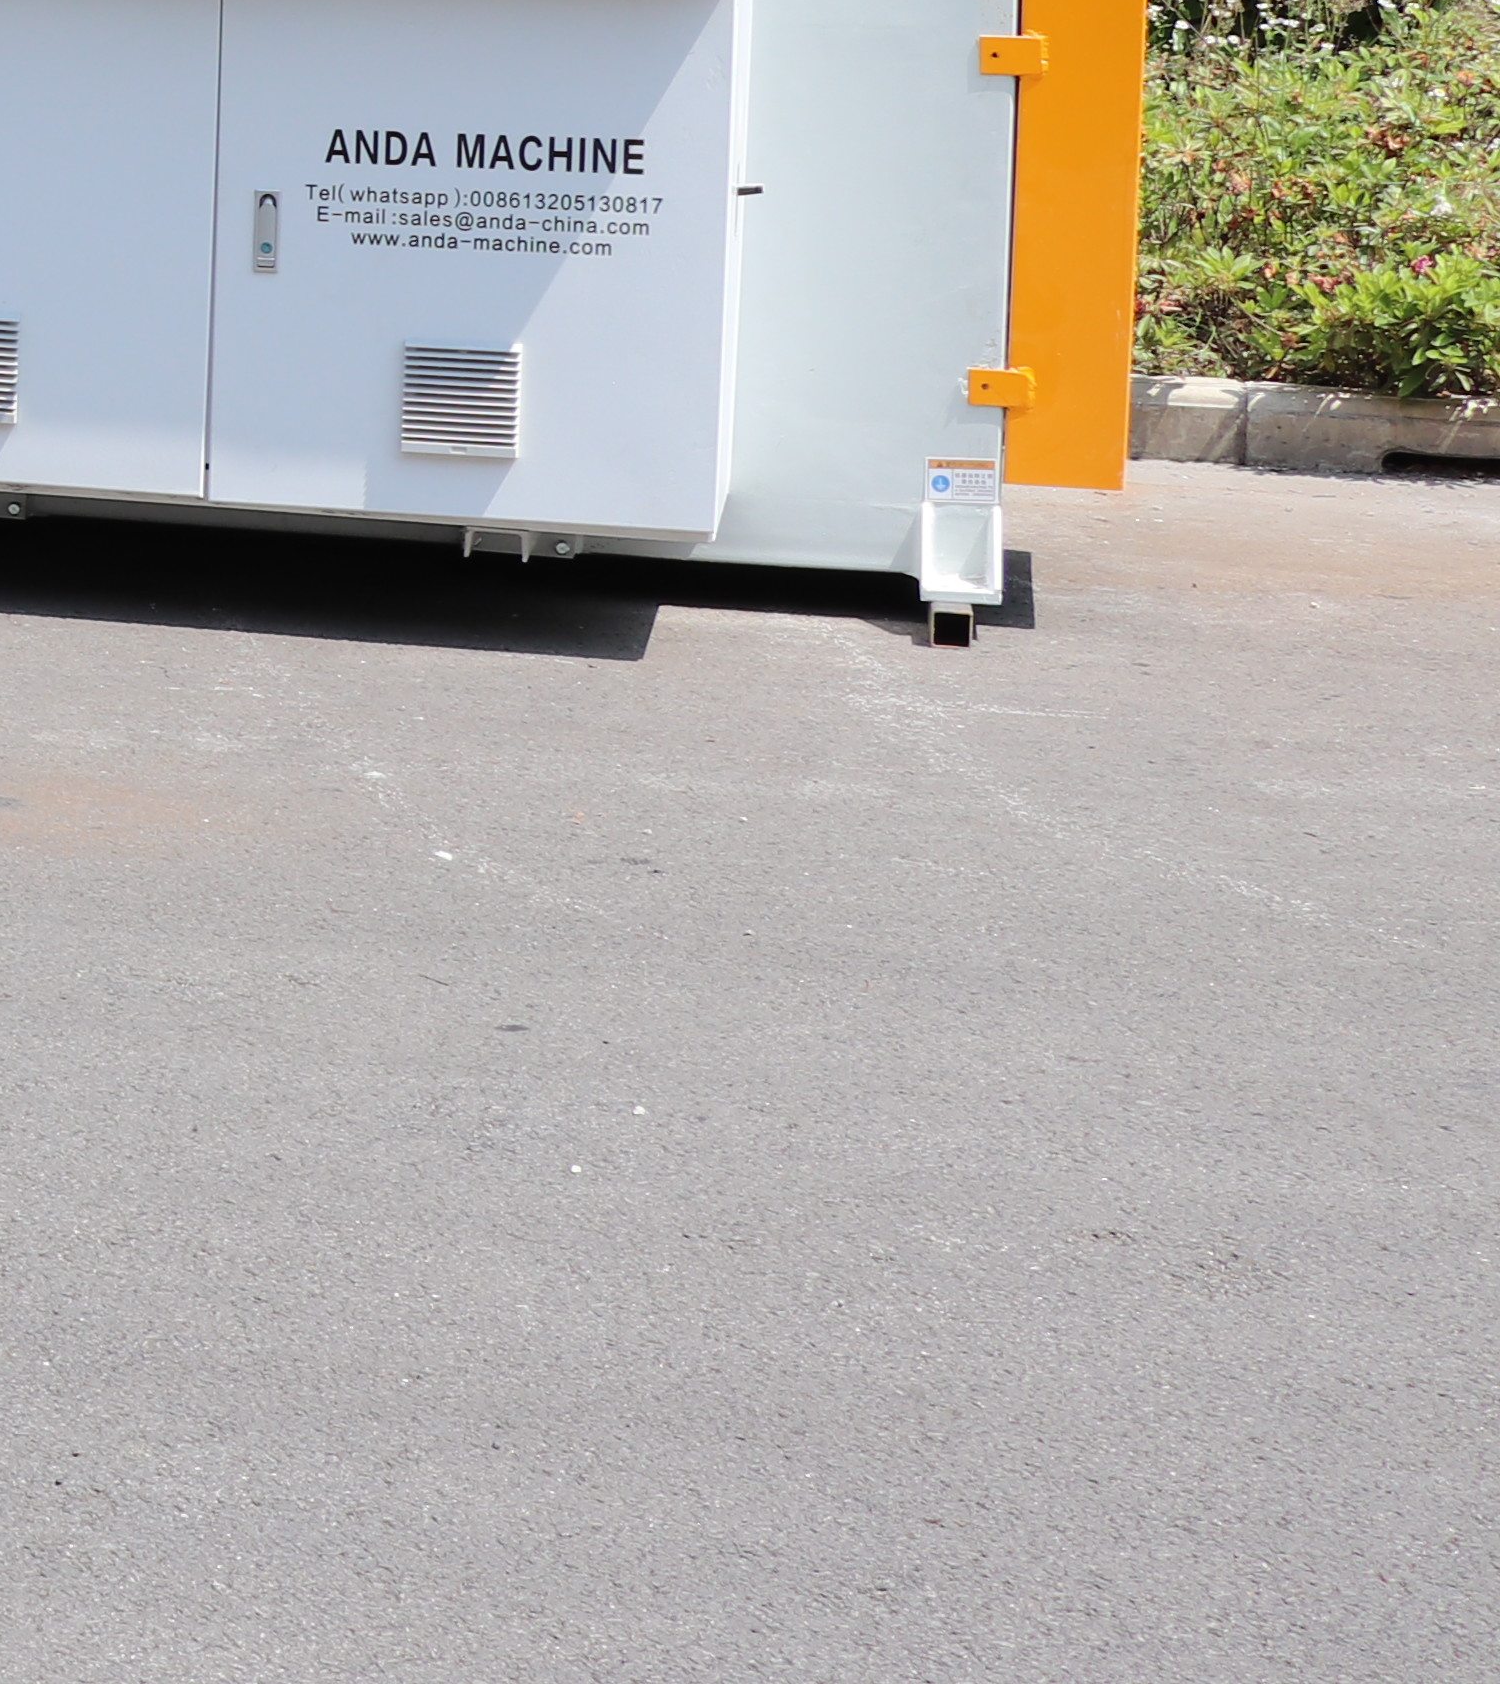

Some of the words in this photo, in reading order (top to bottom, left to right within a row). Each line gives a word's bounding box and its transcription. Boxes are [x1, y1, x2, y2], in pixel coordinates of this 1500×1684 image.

[325, 128, 437, 167] ANDA
[456, 133, 646, 175] MACHINE
[351, 232, 613, 256] www.anda-machine.com
